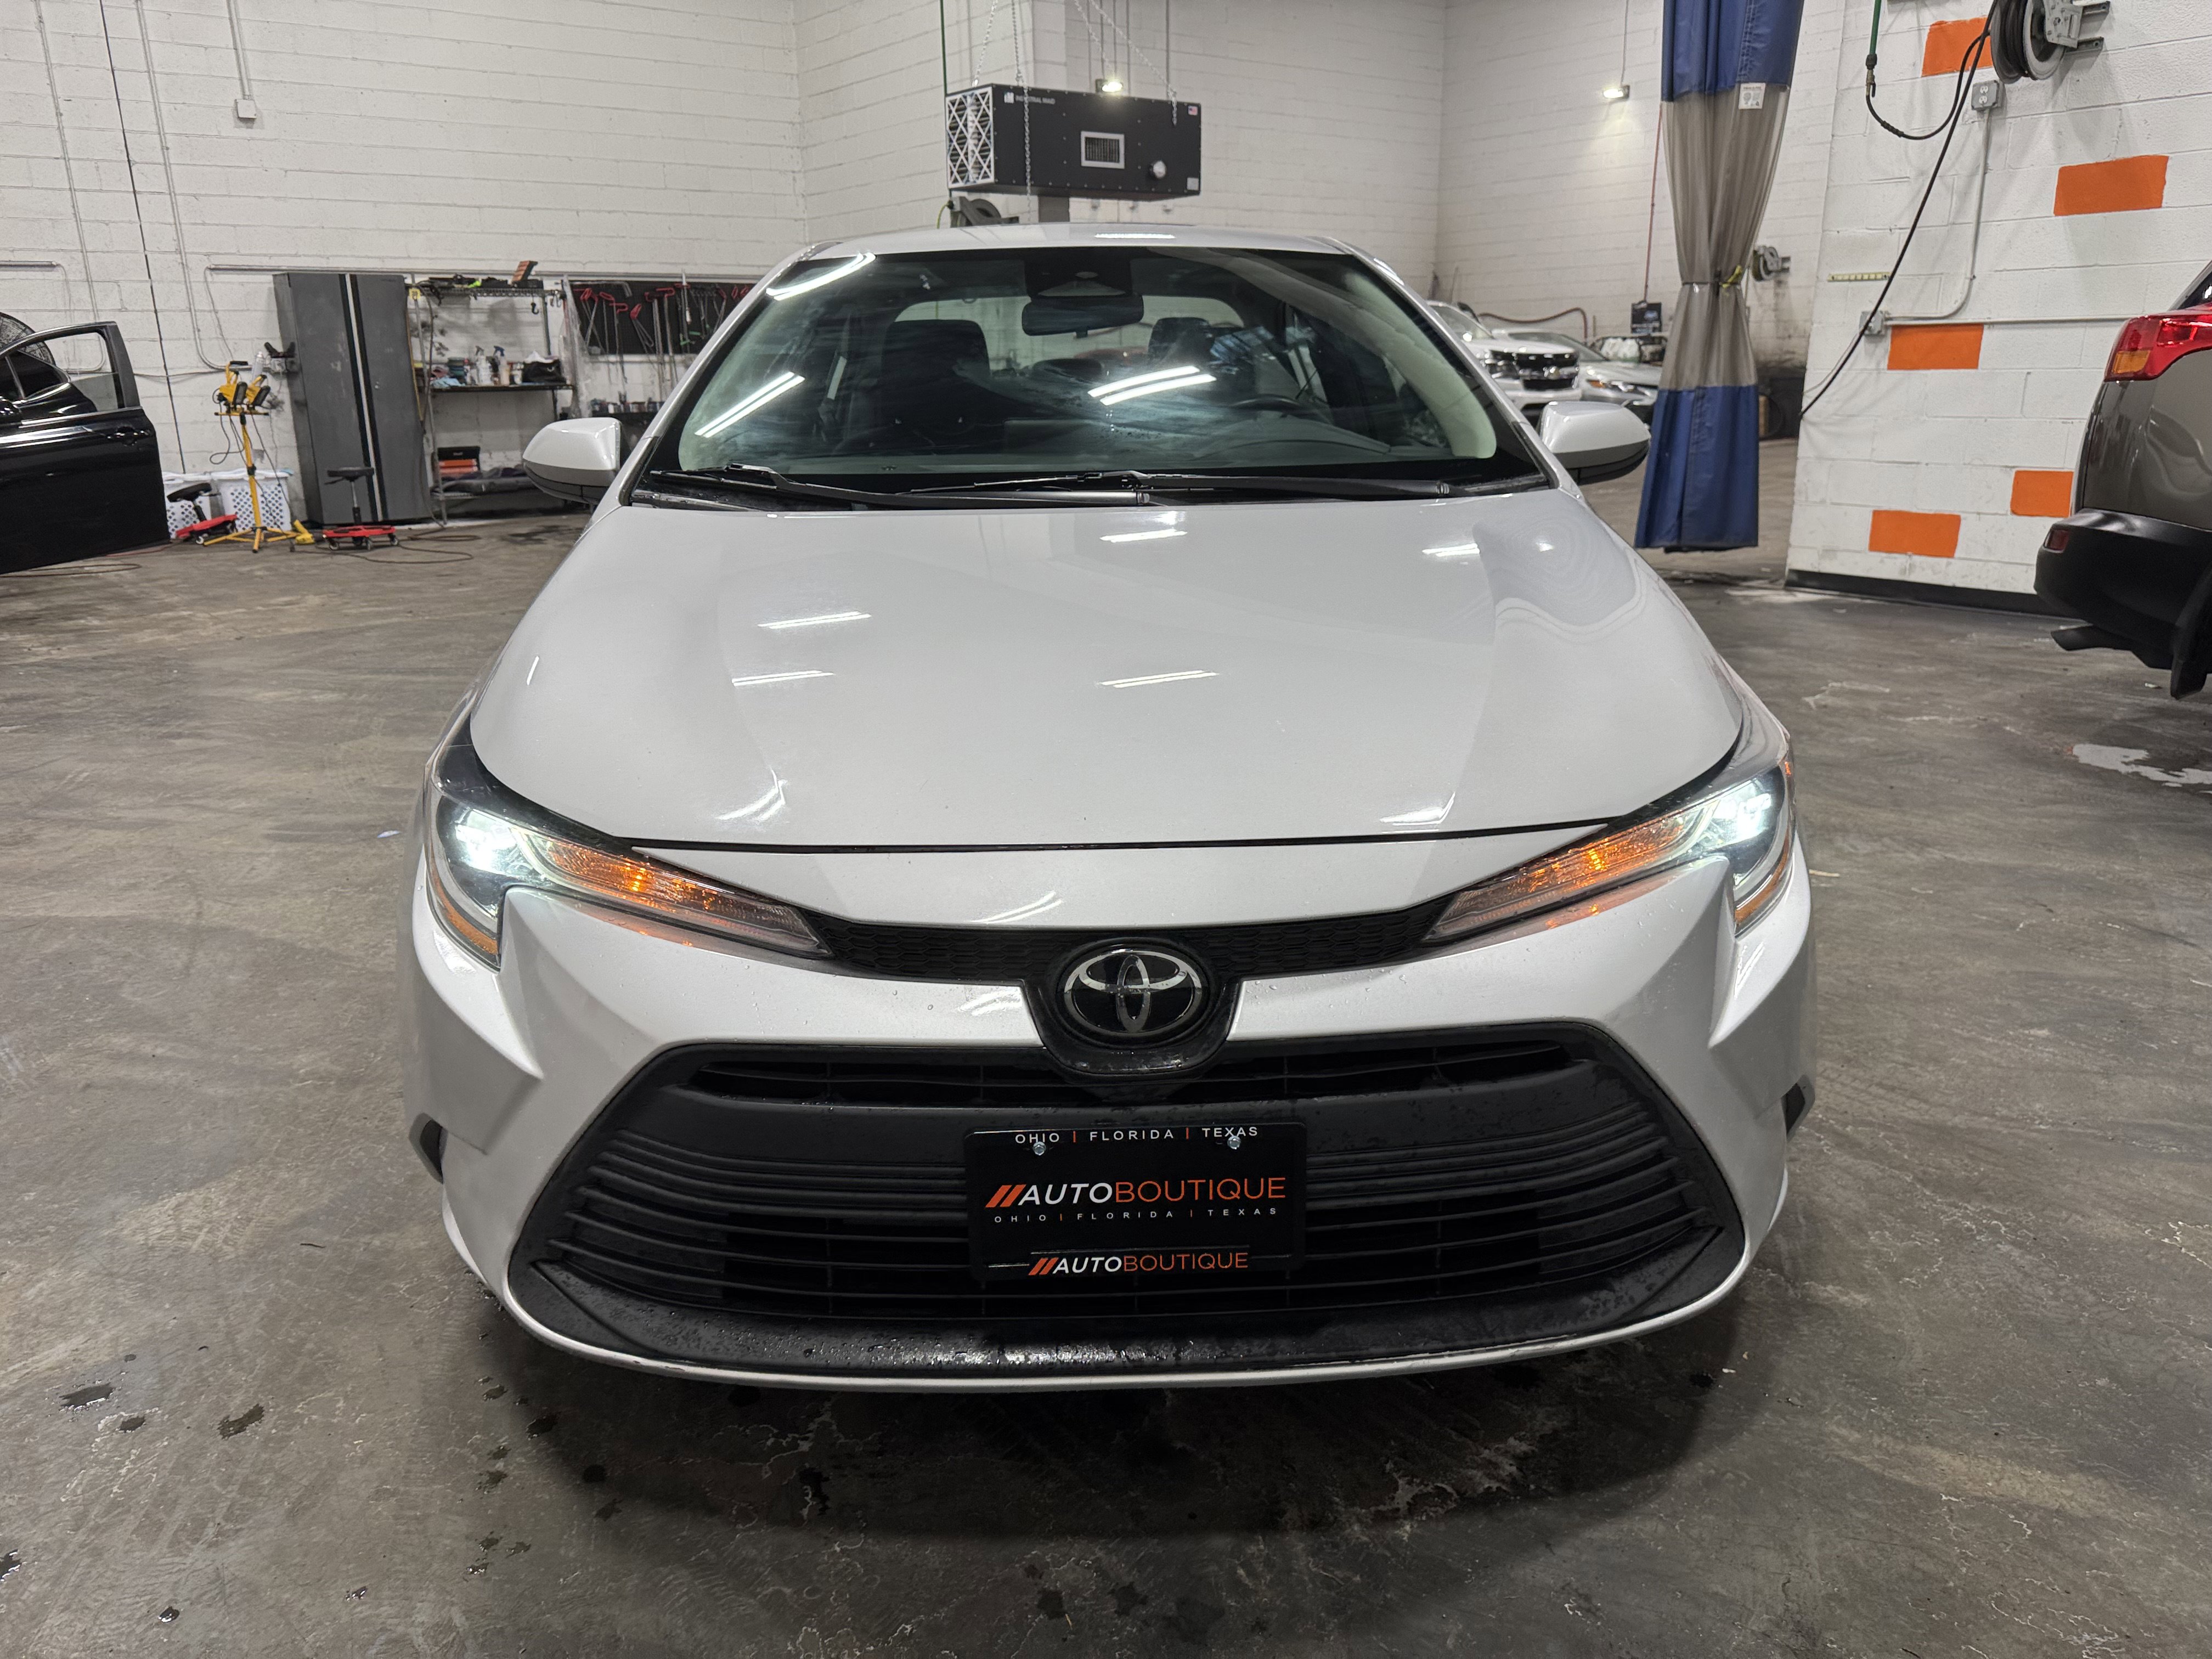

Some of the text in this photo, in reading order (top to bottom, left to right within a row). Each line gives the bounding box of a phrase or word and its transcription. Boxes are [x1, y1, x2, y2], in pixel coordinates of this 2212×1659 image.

[1015, 1126, 1258, 1144] OHIO FLORIDA TEXAS
[994, 1207, 1276, 1223] OHIO FLORIDA TEXAS
